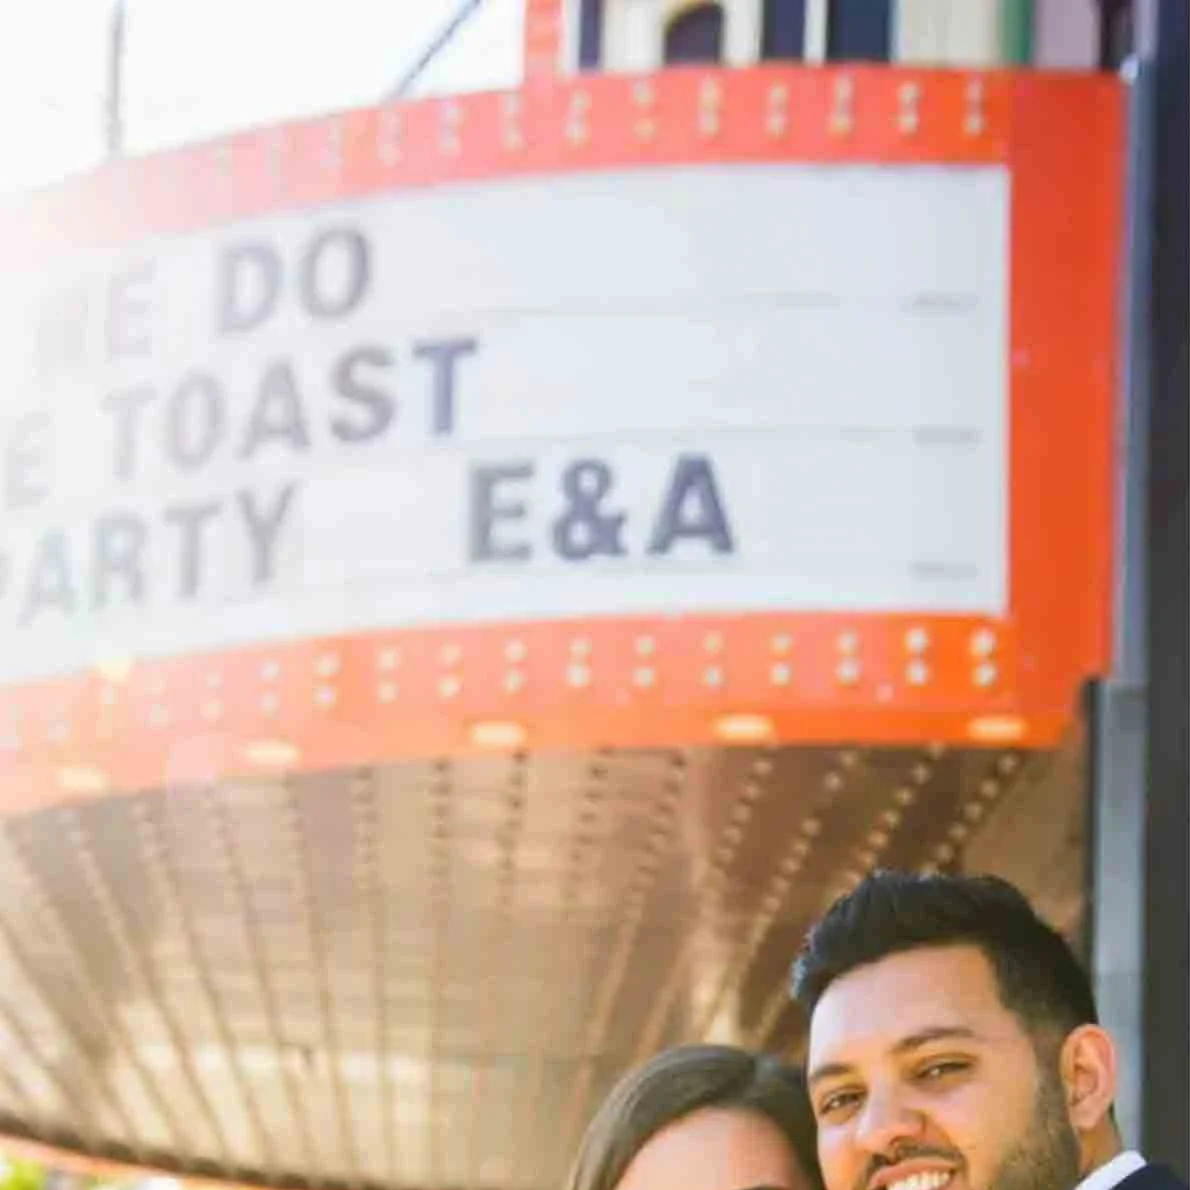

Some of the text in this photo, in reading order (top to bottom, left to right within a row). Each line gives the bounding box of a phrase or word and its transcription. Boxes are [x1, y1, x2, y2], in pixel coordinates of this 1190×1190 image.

[215, 222, 377, 338] DO
[100, 332, 482, 482] TOAST
[466, 451, 736, 566] E&A
